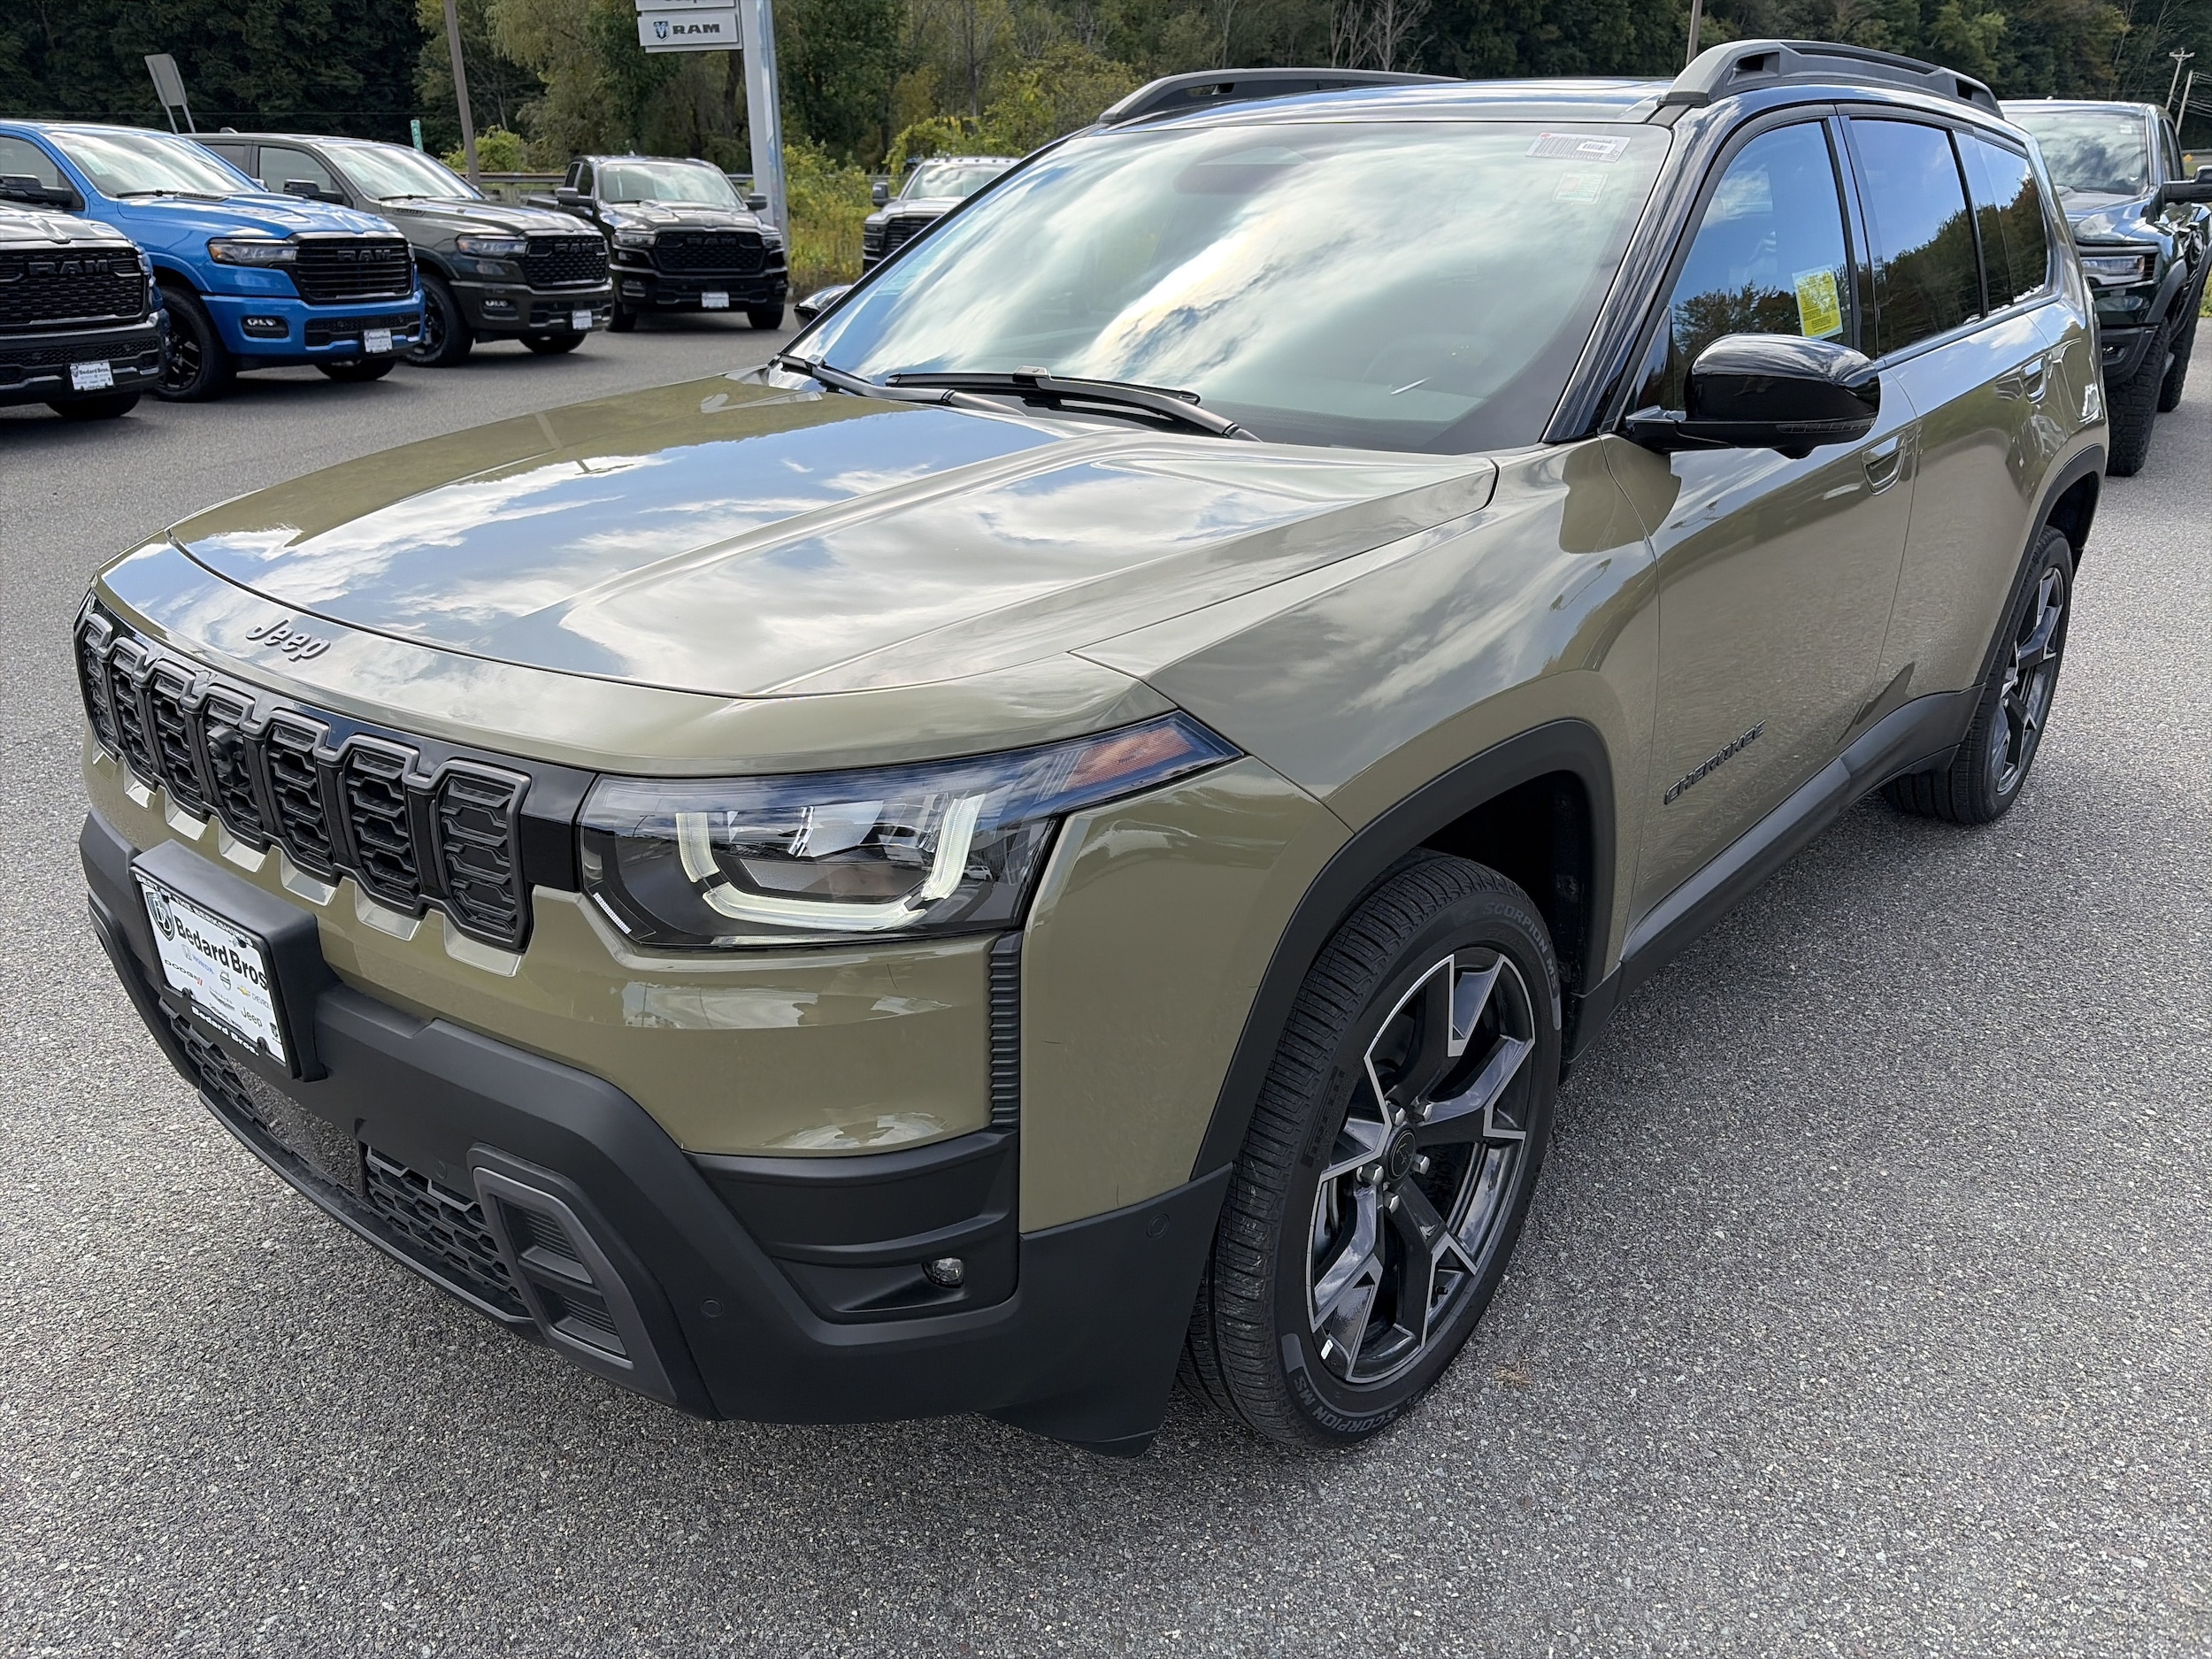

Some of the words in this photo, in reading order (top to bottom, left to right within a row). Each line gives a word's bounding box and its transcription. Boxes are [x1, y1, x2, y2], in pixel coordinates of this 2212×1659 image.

[672, 24, 720, 35] RAM
[28, 259, 110, 274] RAM
[337, 250, 390, 261] RAM
[246, 619, 331, 662] Jeep
[1664, 719, 1765, 805] CHEROKEE
[134, 873, 158, 892] BEST
[174, 915, 229, 967] Bedard
[1483, 902, 1548, 954] SCORPION
[1547, 957, 1559, 989] MS
[164, 958, 199, 982] DODGE
[241, 1006, 262, 1028] Jeep
[191, 1005, 229, 1036] Bedard
[230, 1031, 259, 1056] Bros.
[1294, 1376, 1316, 1406] MS
[1313, 1407, 1399, 1432] SCORPION
